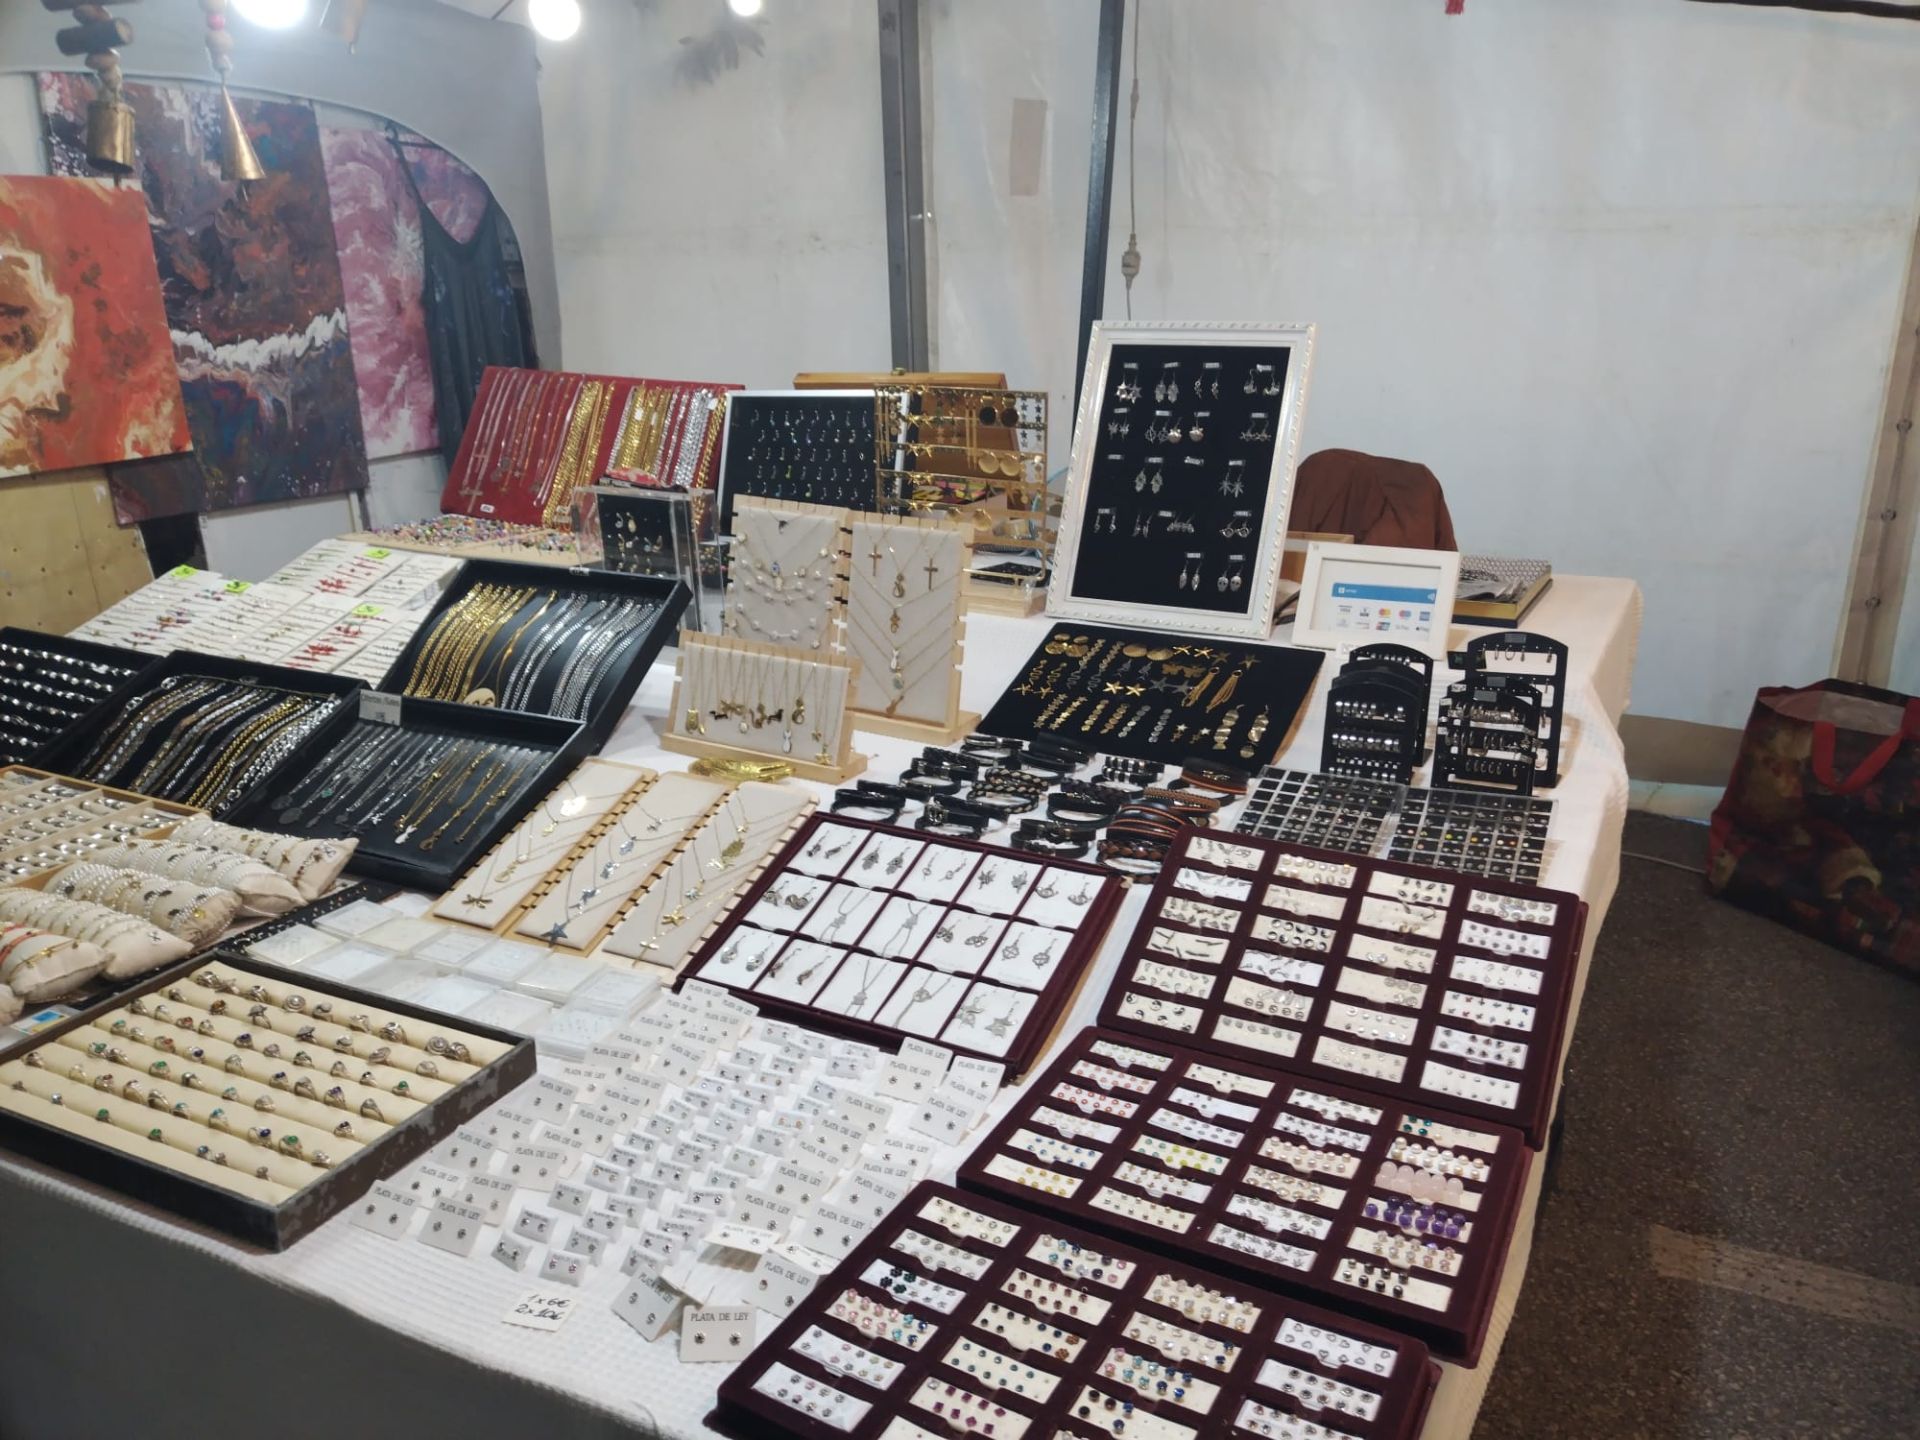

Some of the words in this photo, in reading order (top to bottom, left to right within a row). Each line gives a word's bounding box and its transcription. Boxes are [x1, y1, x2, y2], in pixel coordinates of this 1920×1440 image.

[908, 1044, 923, 1053] PLATA
[935, 1051, 947, 1059] LEY
[889, 1061, 907, 1071] PLATA
[909, 1066, 919, 1074] DE
[958, 1061, 975, 1069] PLATA
[951, 1081, 966, 1091] PLATA
[967, 1088, 975, 1096] DE
[976, 1093, 987, 1101] LEY
[847, 1096, 863, 1107] PLATA
[875, 1106, 886, 1115] LEY
[928, 1097, 944, 1109] PLATA
[945, 1106, 955, 1114] DE
[955, 1109, 967, 1118] LEY
[497, 1109, 512, 1119] PLATA
[522, 1117, 533, 1125] LEY
[822, 1120, 838, 1131] PLATA
[840, 1126, 850, 1134] DE
[850, 1130, 862, 1139] LEY
[458, 1131, 473, 1142] PLATA
[473, 1137, 482, 1145] DE
[482, 1141, 493, 1149] LEY
[885, 1139, 903, 1148] PLATA
[905, 1142, 915, 1150] DE
[916, 1145, 929, 1153] LEY
[515, 1148, 534, 1156] PLATA
[536, 1149, 545, 1158] DE
[801, 1142, 816, 1154] PLATA
[817, 1149, 827, 1158] DE
[826, 1155, 839, 1164] LEY
[420, 1166, 436, 1176] PLATA
[780, 1167, 797, 1178] PLATA
[798, 1173, 809, 1181] DE
[810, 1177, 822, 1186] LEY
[864, 1163, 882, 1172] PLATA
[895, 1169, 908, 1177] LEY
[472, 1176, 490, 1186] PLATA
[855, 1176, 873, 1188] PLATA
[874, 1184, 884, 1193] DE
[885, 1190, 897, 1200] LEY
[375, 1187, 391, 1197] PLATA
[392, 1193, 402, 1201] DE
[402, 1198, 415, 1206] LEY
[746, 1194, 763, 1206] PLATA
[767, 1201, 776, 1210] DE
[777, 1205, 790, 1215] LEY
[439, 1202, 456, 1213] PLATA
[457, 1207, 467, 1216] DE
[468, 1212, 480, 1220] LEY
[818, 1208, 837, 1221] PLATA
[839, 1215, 850, 1225] DE
[852, 1220, 865, 1229] LEY
[765, 1261, 785, 1276] PLATA
[786, 1271, 795, 1280] DE
[797, 1276, 810, 1286] LEY
[691, 1312, 715, 1321] PLATA
[719, 1313, 731, 1321] DE
